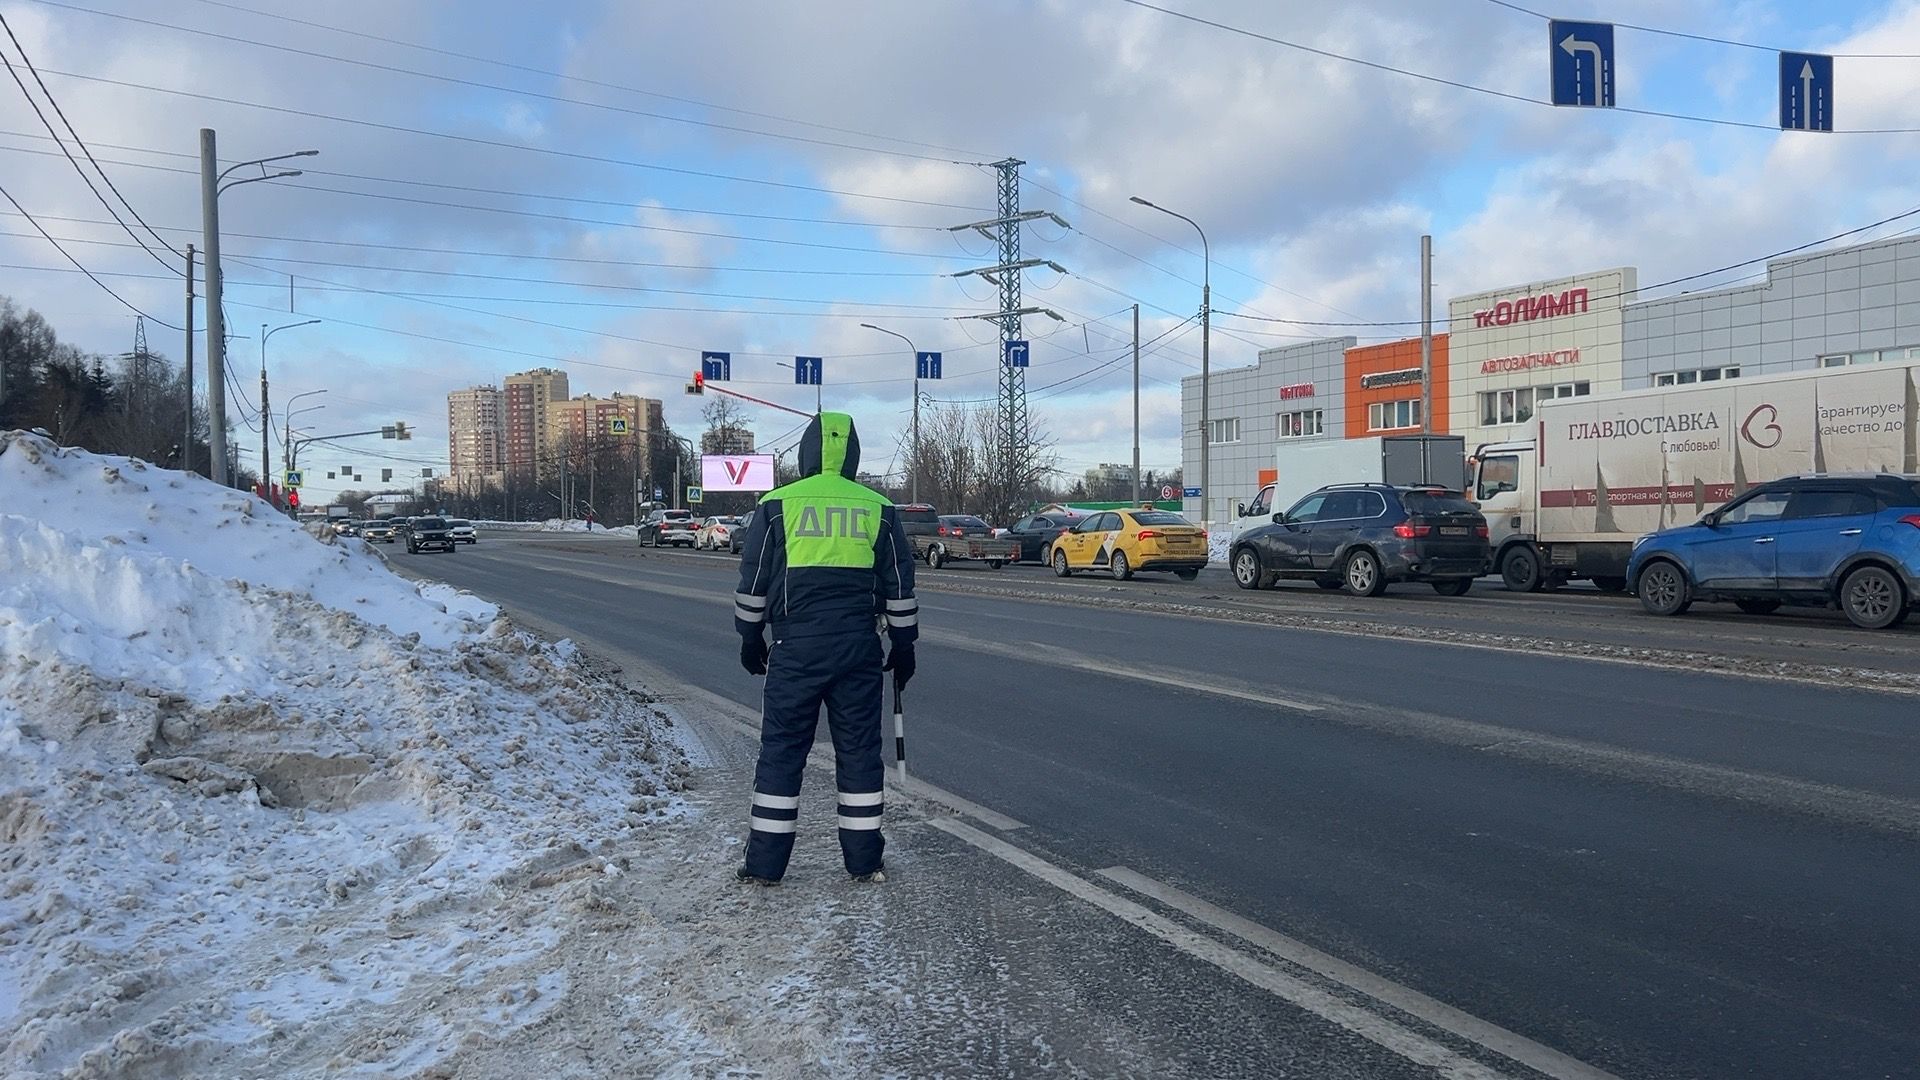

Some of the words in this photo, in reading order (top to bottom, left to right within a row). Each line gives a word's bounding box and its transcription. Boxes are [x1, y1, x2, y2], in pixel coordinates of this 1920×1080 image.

[1495, 288, 1588, 326] ОЛИМП
[1480, 347, 1580, 374] АВТОЗАПЧАСТИ
[1568, 411, 1719, 440] ГЛАВДОСТАВКА
[1884, 421, 1905, 433] до
[1670, 437, 1720, 454] любовью!
[722, 460, 750, 485] V
[795, 506, 870, 539] ДПС
